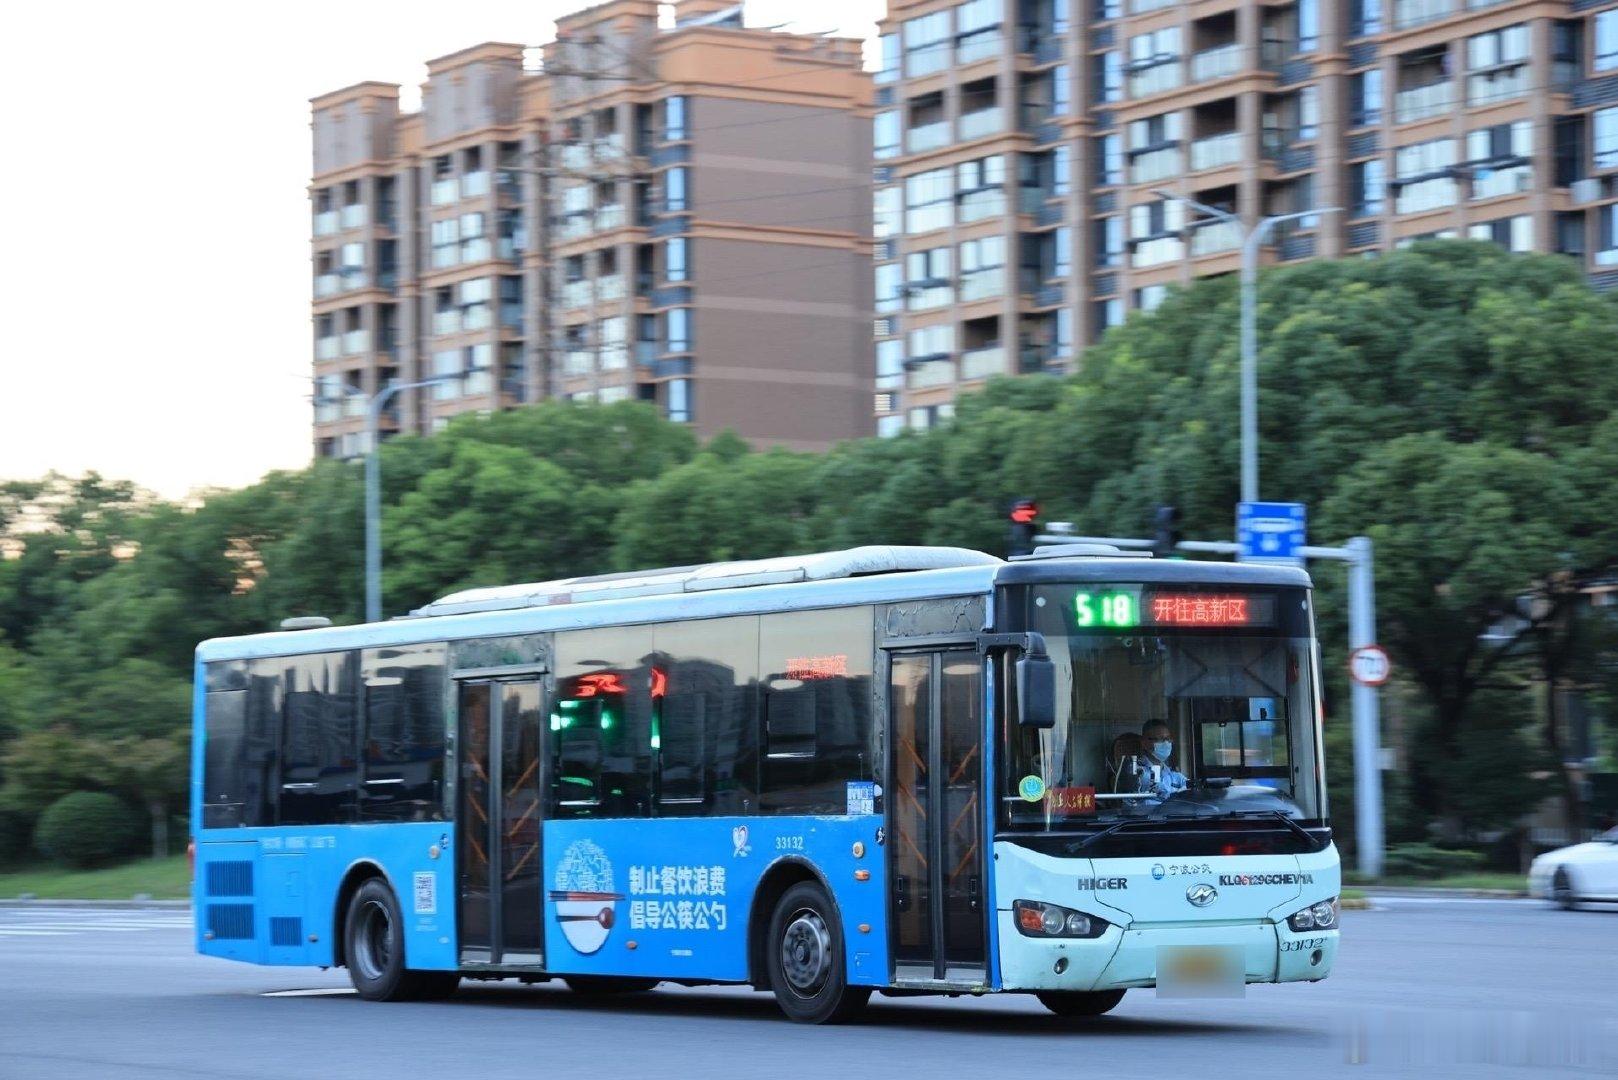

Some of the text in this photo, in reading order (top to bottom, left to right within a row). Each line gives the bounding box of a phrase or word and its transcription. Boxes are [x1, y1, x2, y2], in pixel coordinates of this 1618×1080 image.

[1075, 593, 1129, 626] 518
[1154, 597, 1247, 623] 开往高新区
[775, 836, 804, 850] 33132
[1169, 863, 1212, 875] 宁波公交
[628, 865, 727, 896] 制止餐饮浪费
[1077, 877, 1128, 891] HIGER
[628, 900, 727, 931] 倡导公筷公勺
[1280, 937, 1324, 952] 33132
